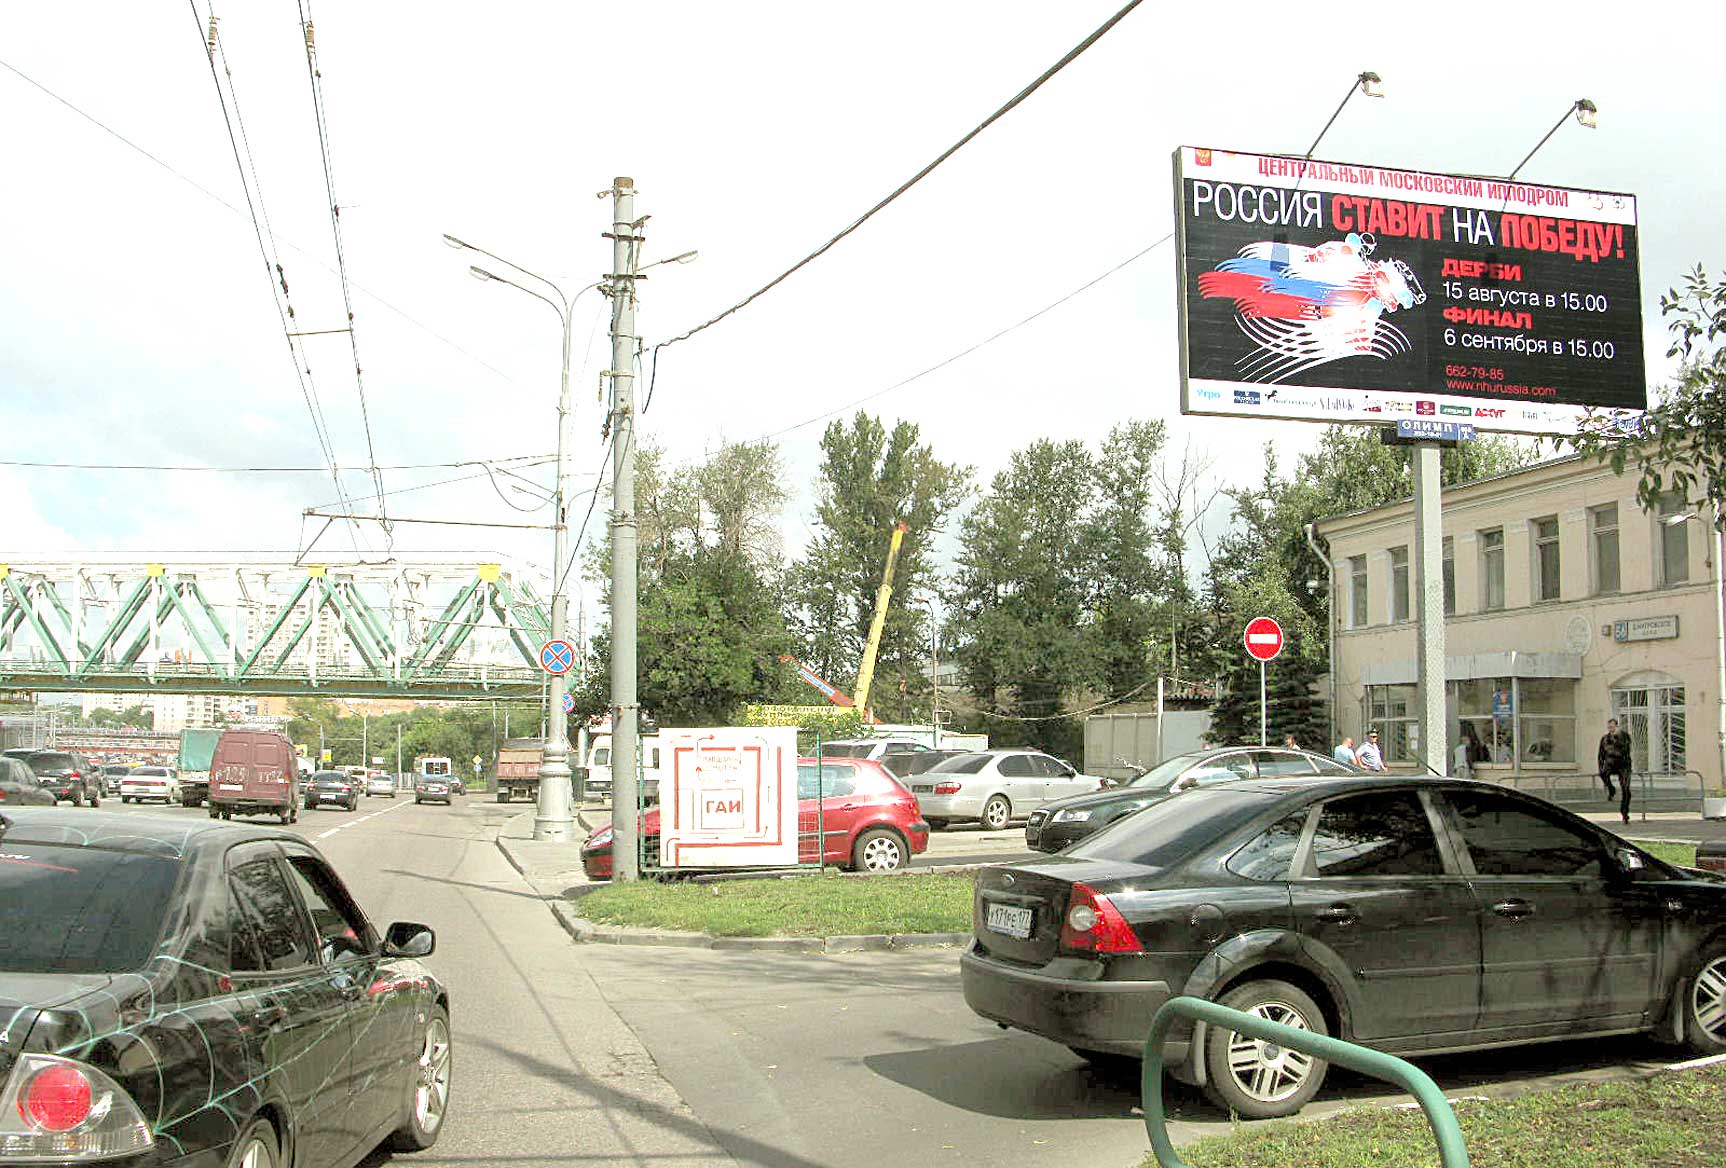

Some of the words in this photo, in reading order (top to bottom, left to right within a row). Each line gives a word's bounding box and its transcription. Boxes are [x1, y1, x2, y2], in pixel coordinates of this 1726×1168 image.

[1193, 180, 1323, 229] РОССИЯ
[1331, 194, 1445, 241] СТАВИТ
[1452, 207, 1495, 246] НА
[1501, 213, 1625, 263] ПОБЕДУ!
[1441, 258, 1522, 281] ДЕРБИ
[1443, 281, 1463, 299] 15
[1468, 286, 1540, 307] августа
[1546, 295, 1556, 307] в
[1561, 292, 1607, 313] 15.00
[1443, 306, 1533, 329] ФИНАЛ
[1444, 328, 1456, 346] 6
[1461, 333, 1548, 355] сентября
[1553, 342, 1563, 355] в
[1568, 339, 1614, 359] 15.00
[1402, 420, 1453, 433] ОЛИМП
[706, 800, 741, 814] ГАИ
